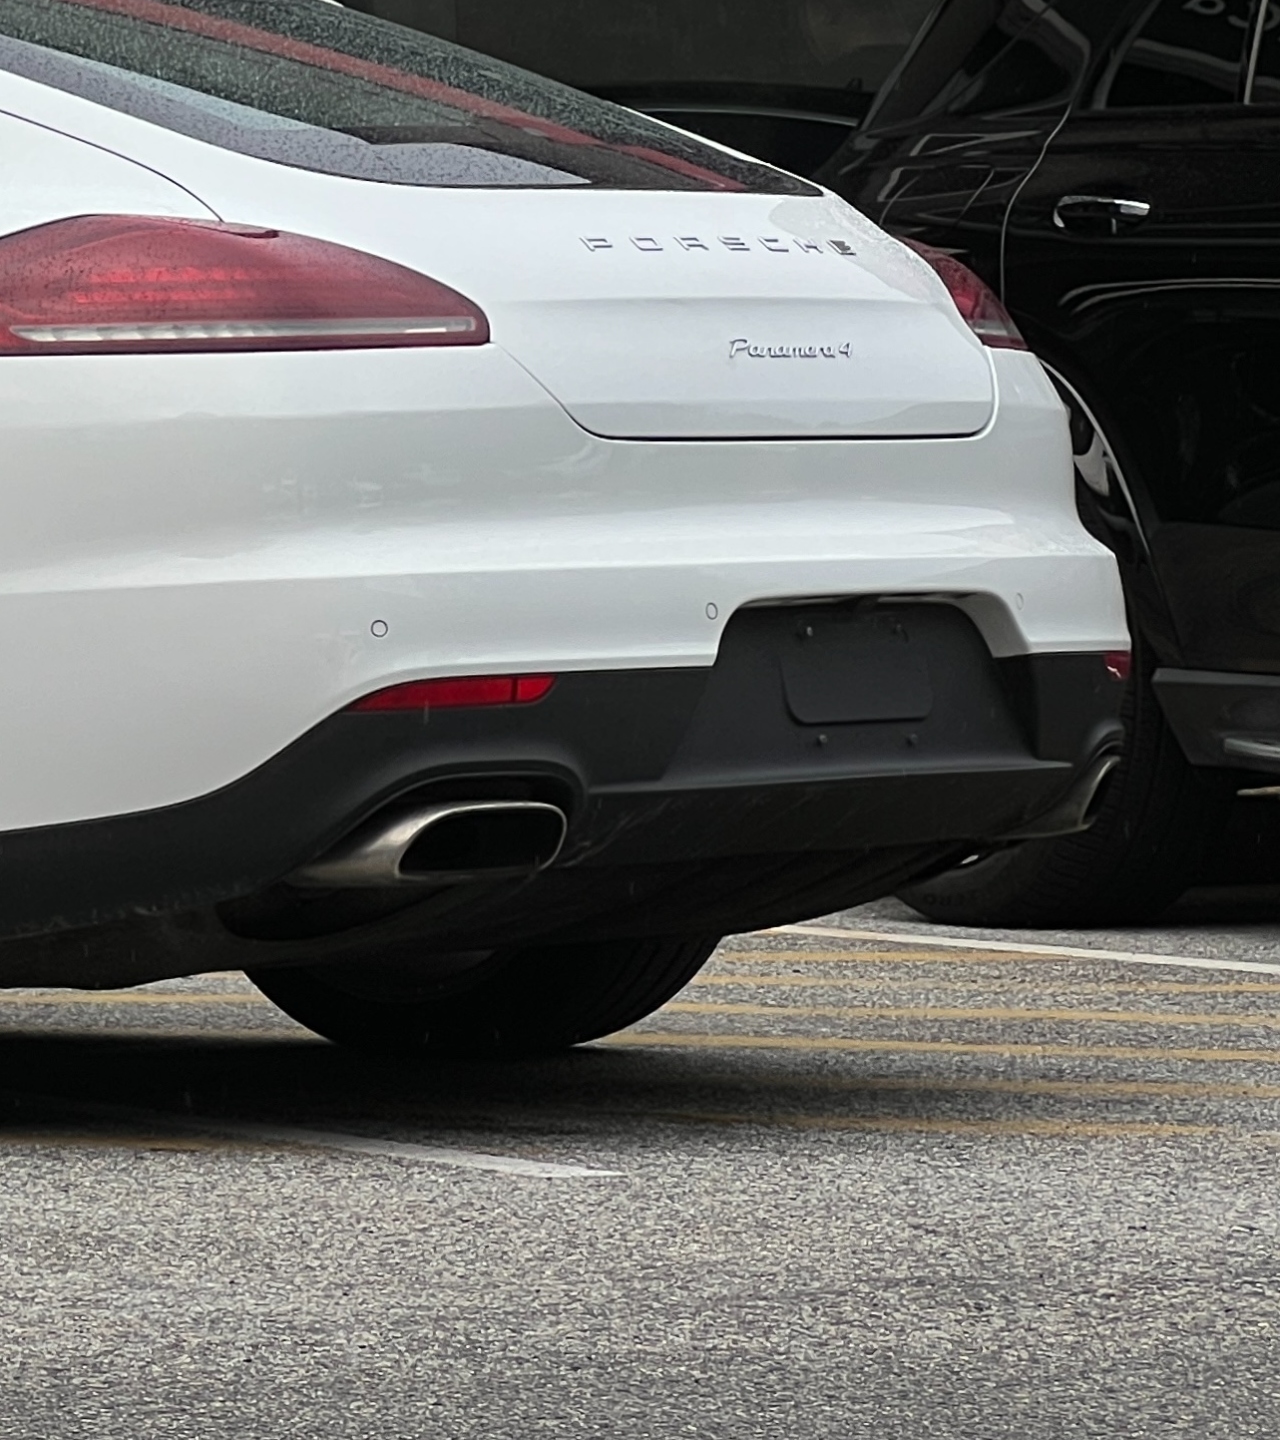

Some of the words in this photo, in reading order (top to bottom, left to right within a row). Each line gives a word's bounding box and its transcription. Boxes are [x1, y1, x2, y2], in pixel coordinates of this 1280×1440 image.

[579, 236, 856, 256] PORSCHE
[729, 338, 836, 358] Panamera
[838, 341, 853, 357] 4
